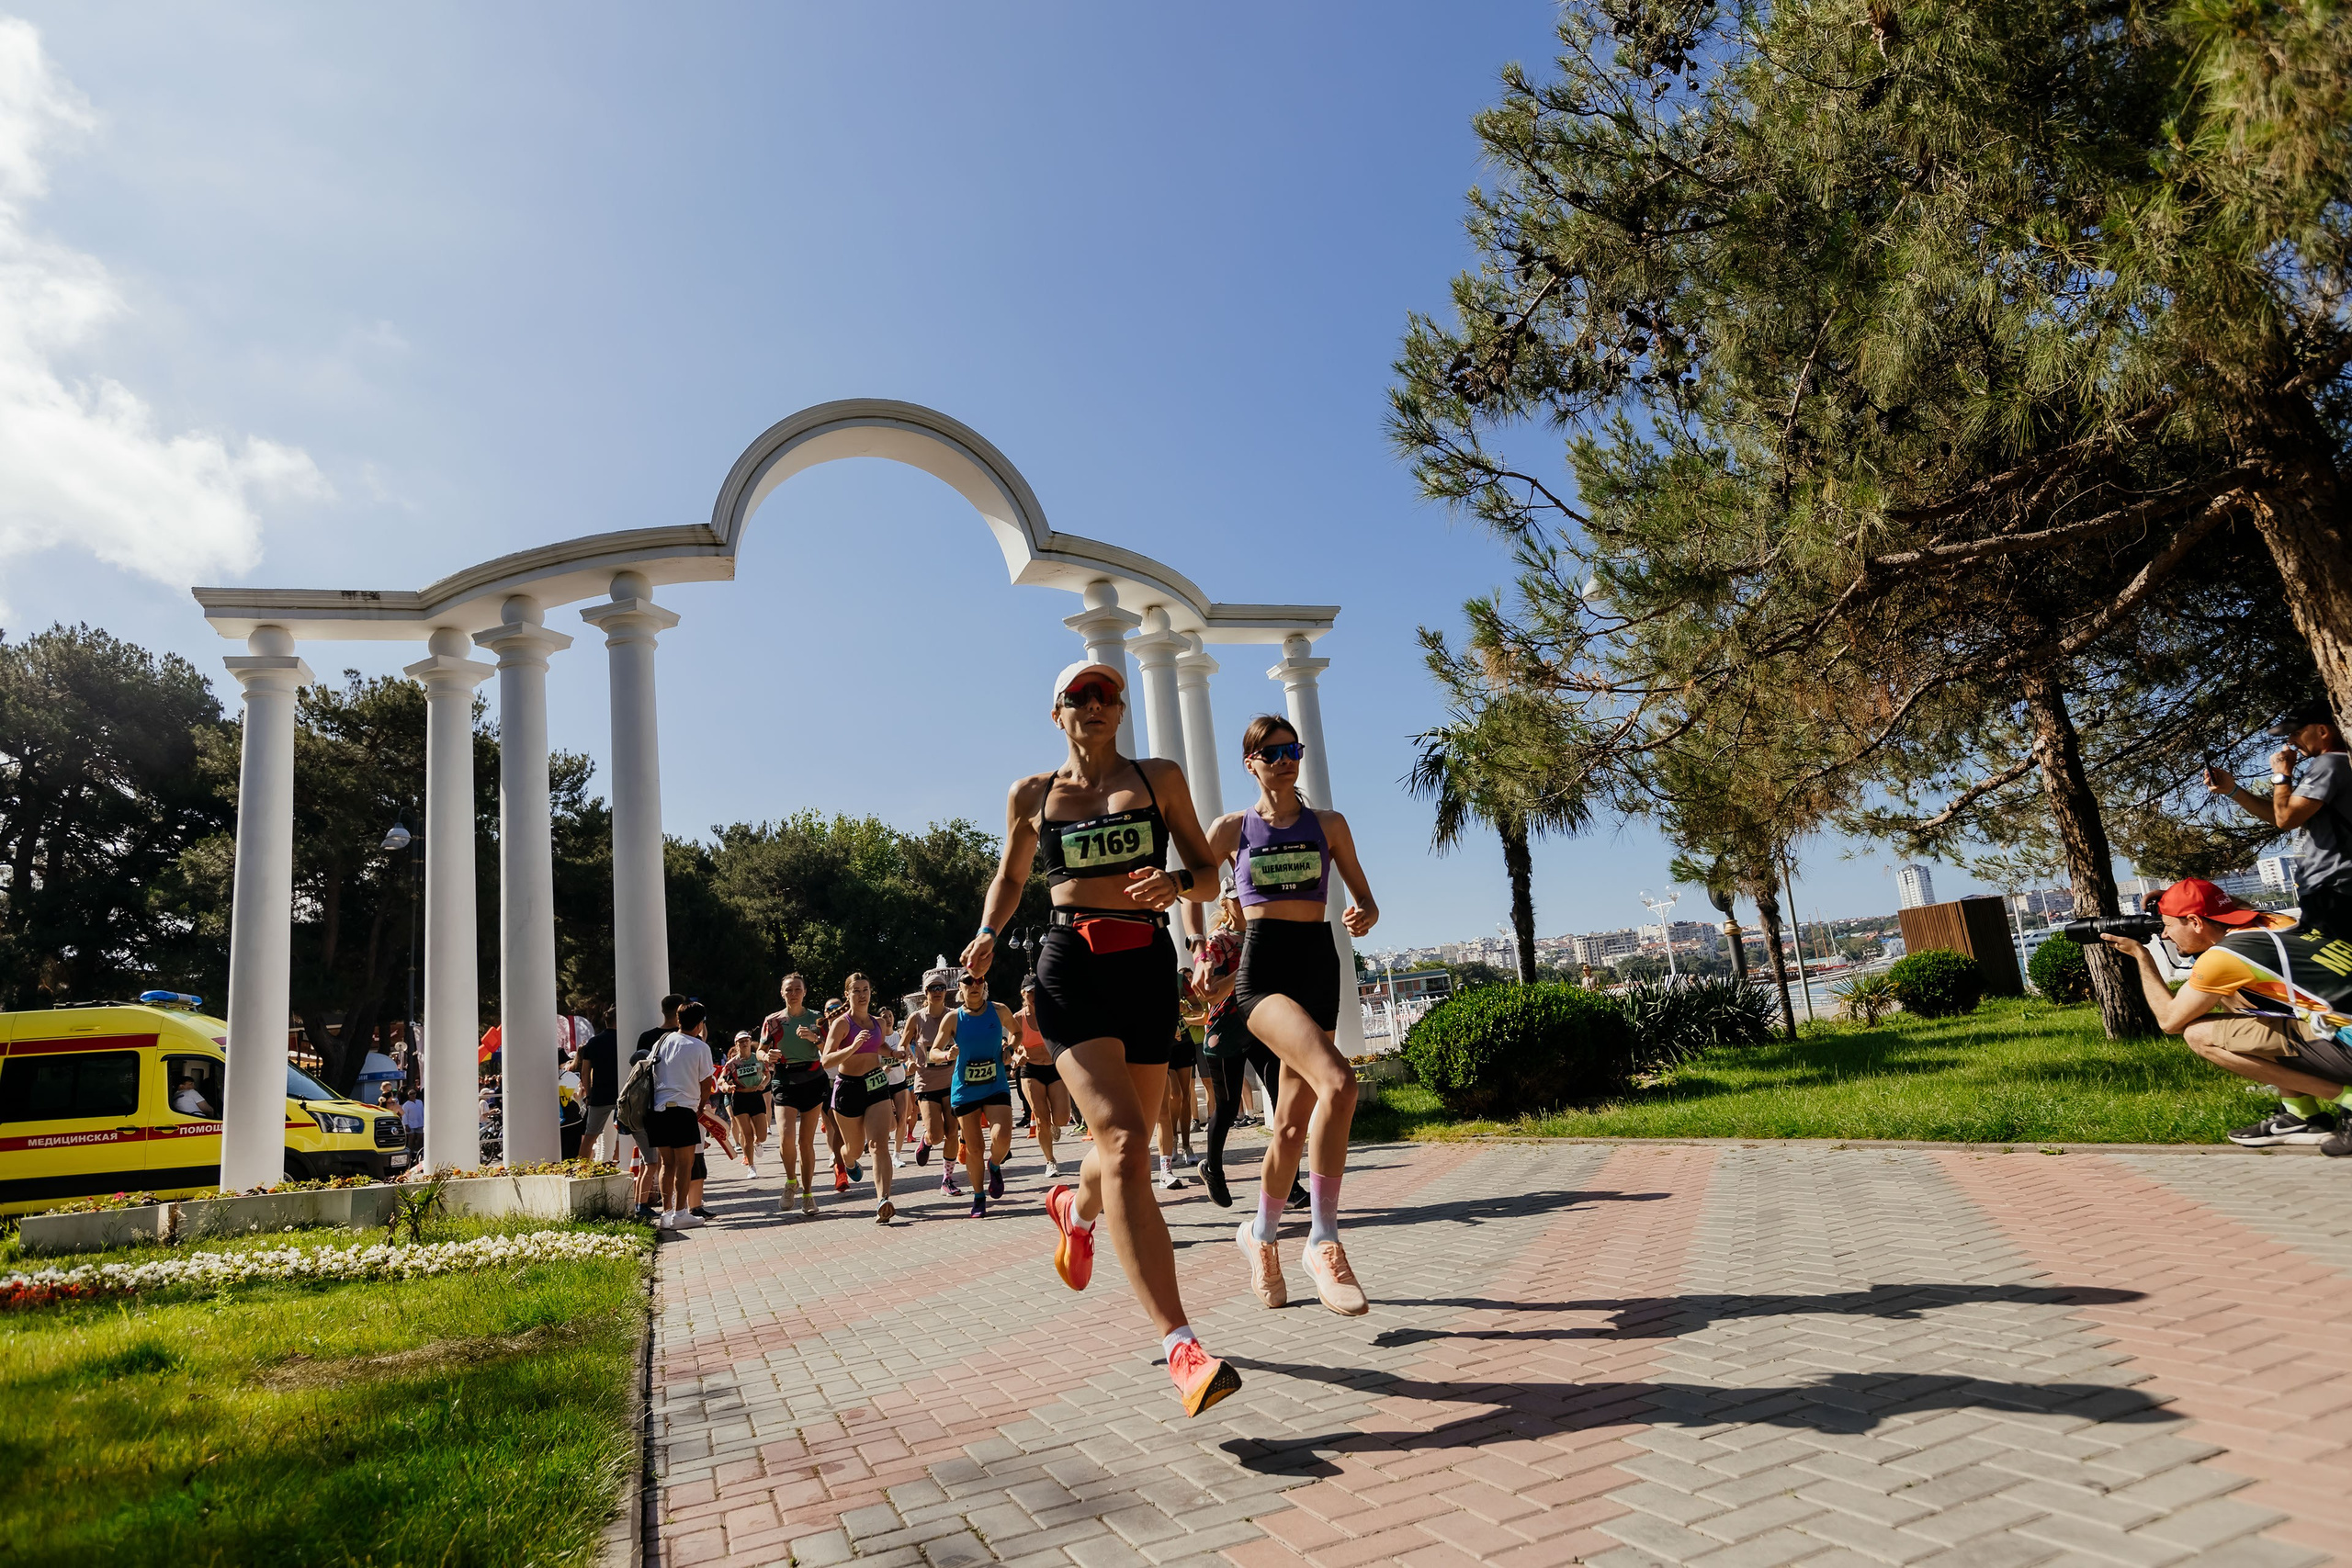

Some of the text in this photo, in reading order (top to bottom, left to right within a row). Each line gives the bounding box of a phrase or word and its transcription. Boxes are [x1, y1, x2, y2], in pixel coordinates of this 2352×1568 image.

[1074, 828, 1141, 860] 7169
[1261, 862, 1311, 874] ШЕМЯКИНА
[1281, 883, 1297, 891] 7210
[968, 1066, 993, 1078] 7224
[28, 1132, 119, 1147] МЕДИЦИНСКАЯ
